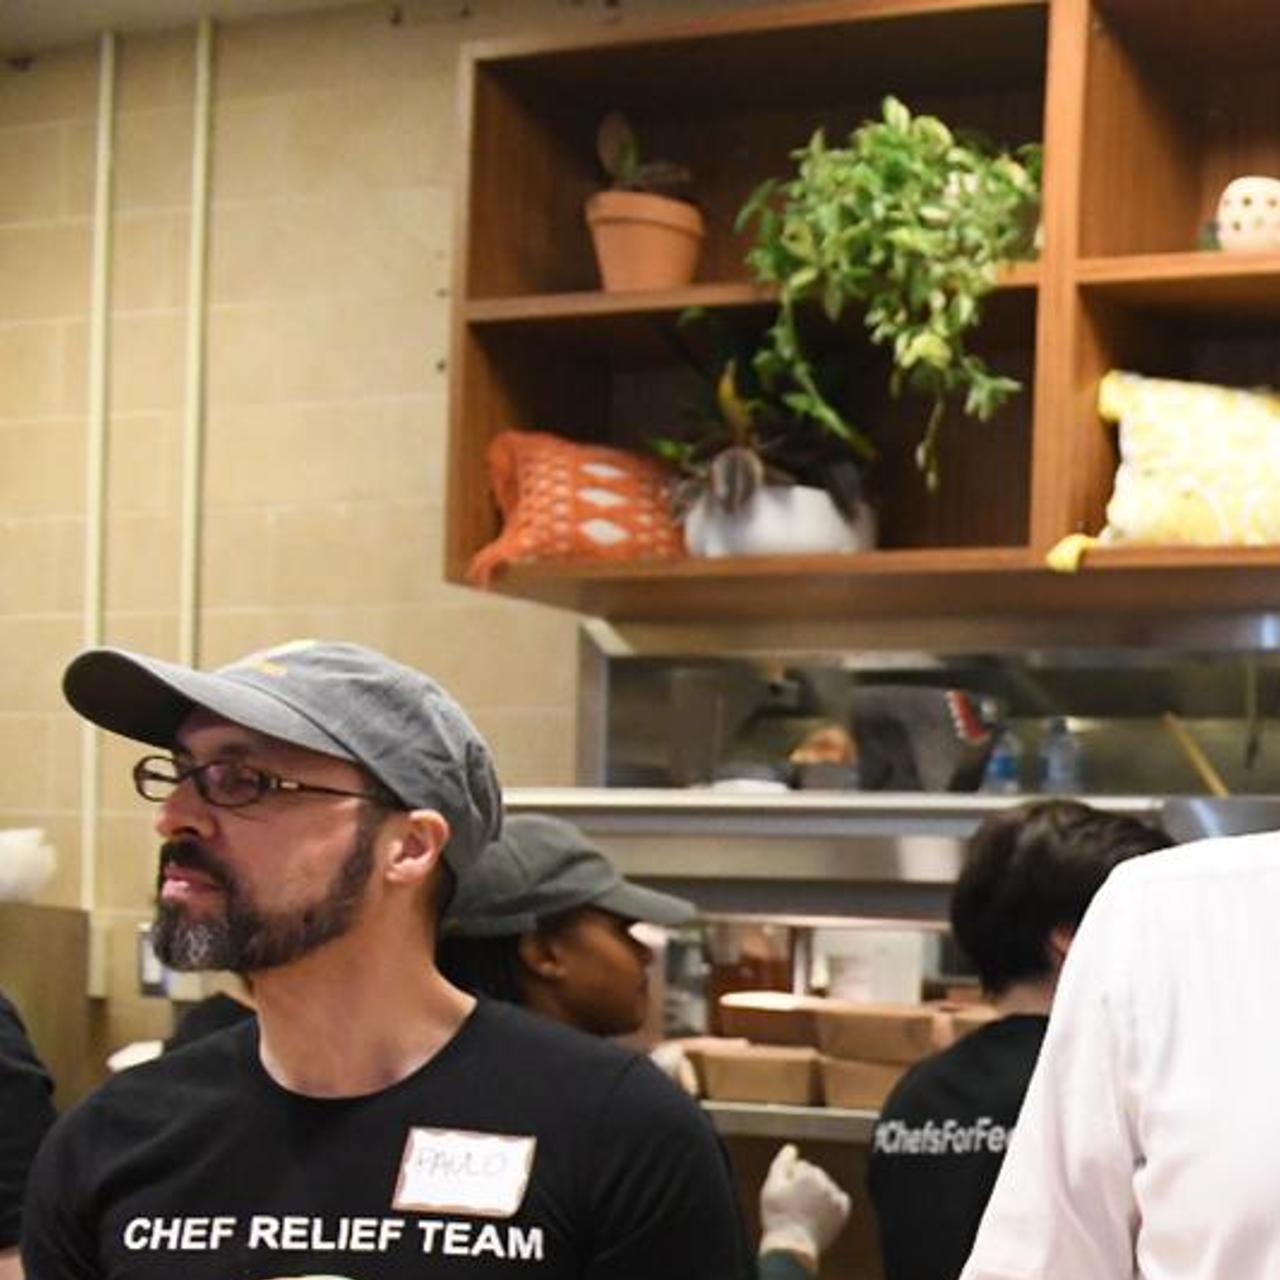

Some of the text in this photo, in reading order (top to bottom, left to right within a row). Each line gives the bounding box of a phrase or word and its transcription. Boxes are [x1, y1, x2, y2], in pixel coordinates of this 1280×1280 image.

[873, 1117, 1010, 1153] #ChefsForFe
[124, 1216, 543, 1259] CHEF RELIEF TEAM
